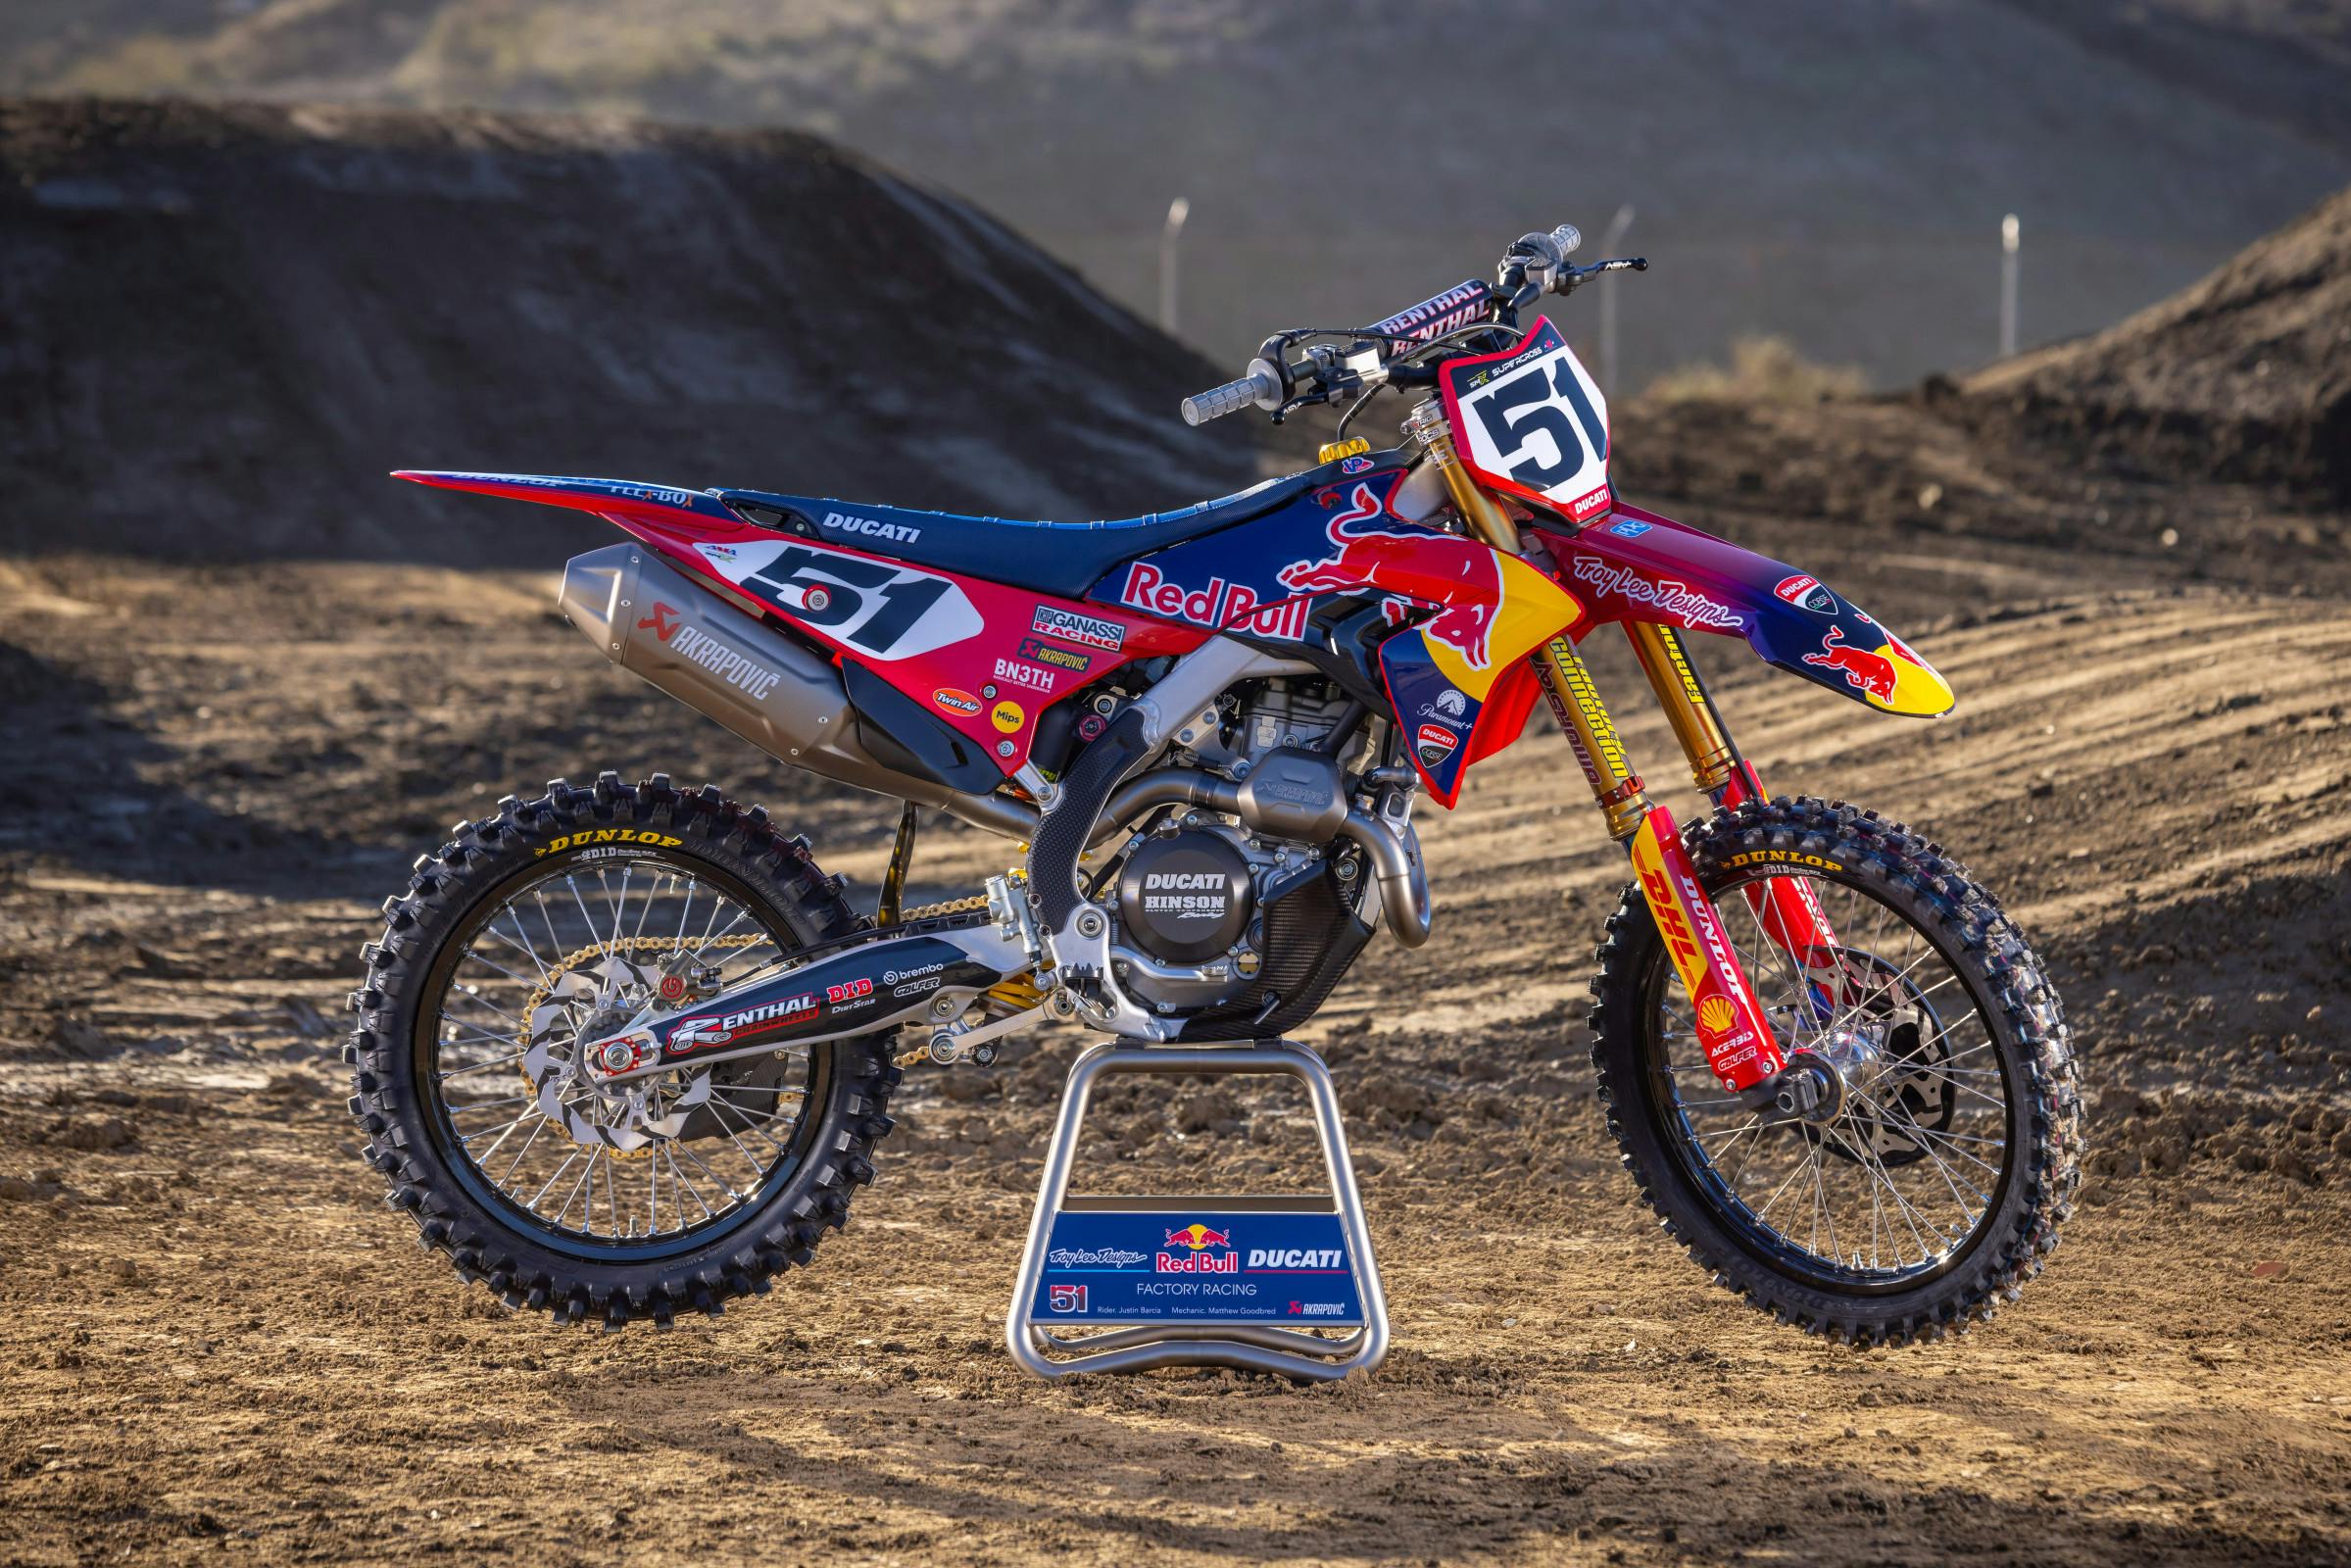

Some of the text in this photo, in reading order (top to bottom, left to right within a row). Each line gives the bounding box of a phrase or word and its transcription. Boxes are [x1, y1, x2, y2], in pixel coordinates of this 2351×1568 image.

[1380, 284, 1483, 334] RENTHAL
[1492, 347, 1543, 377] SUPERCROSS
[1473, 357, 1607, 490] 51
[1575, 489, 1607, 514] DUCATI
[822, 512, 921, 544] DUCATI
[739, 546, 953, 654] 51
[1574, 557, 1742, 628] Troy Lee Designs
[1781, 578, 1812, 597] DUCATI
[1120, 562, 1313, 641] Red Bull
[1034, 621, 1119, 650] RACING
[1053, 612, 1123, 641] GANASSI
[994, 658, 1055, 689] BN3TH
[936, 692, 980, 712] Twin Air
[996, 710, 1020, 724] Mips
[1417, 703, 1473, 730] Paramount+
[1422, 728, 1454, 746] DUCATI
[549, 829, 683, 854] DUNLOP
[1732, 850, 1843, 873] DUNLOP
[1145, 873, 1226, 890] DUCATI
[1145, 896, 1226, 909] HINSON
[1641, 868, 1698, 967] DHL
[1681, 874, 1748, 1005] DUNLOP
[899, 963, 944, 980] brembo
[894, 977, 941, 998] GALFER
[1711, 1031, 1754, 1057] ACERBIS
[1718, 1046, 1758, 1072] GALFER
[1050, 1248, 1148, 1269] Troy Lee Designs
[1155, 1251, 1239, 1273] Red Bull
[1248, 1250, 1343, 1268] DUCATI
[1050, 1285, 1088, 1313] 51
[1137, 1283, 1257, 1296] FACTORY RACING
[1119, 1305, 1139, 1314] Justin
[1240, 1306, 1277, 1315] Goodbred
